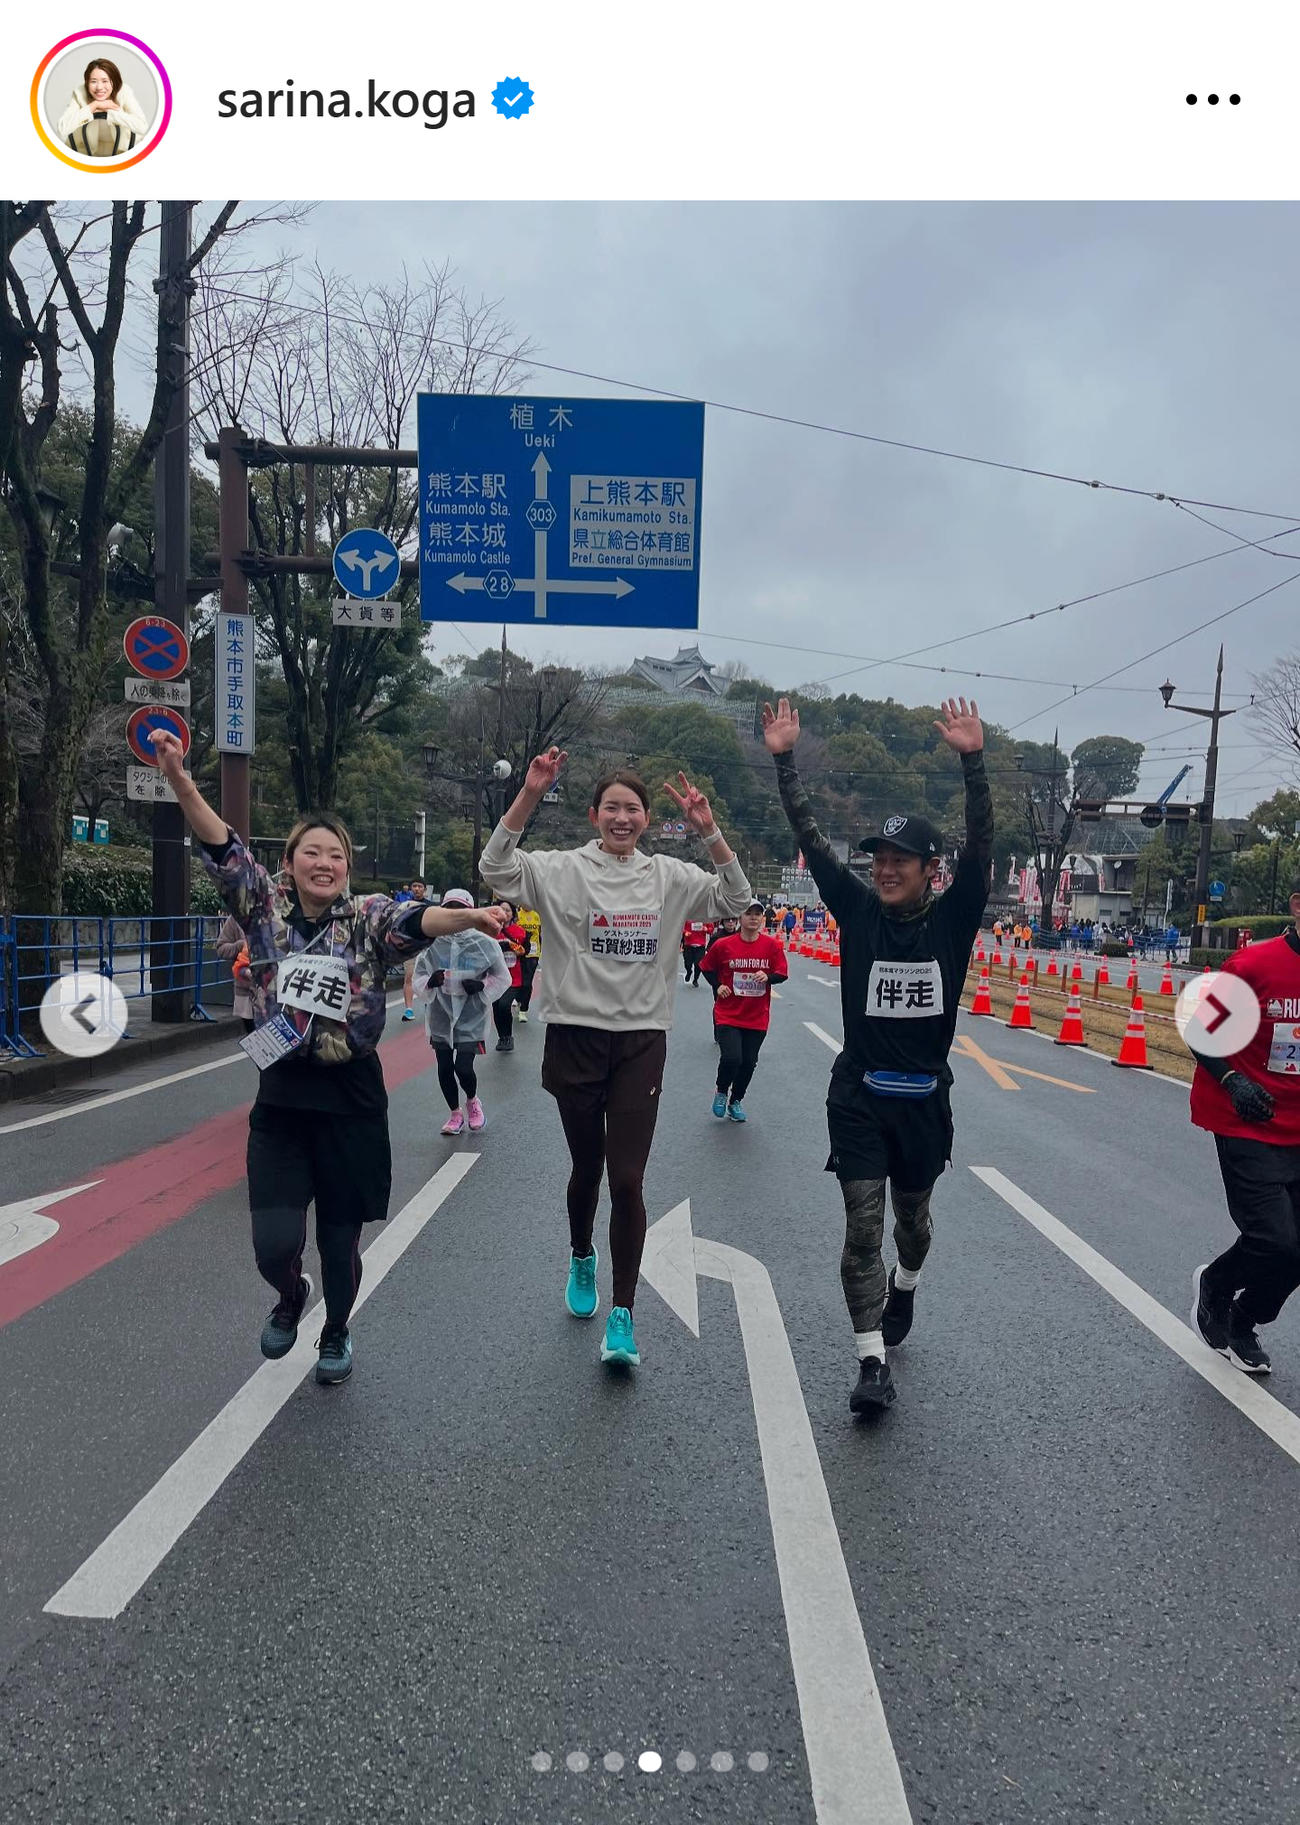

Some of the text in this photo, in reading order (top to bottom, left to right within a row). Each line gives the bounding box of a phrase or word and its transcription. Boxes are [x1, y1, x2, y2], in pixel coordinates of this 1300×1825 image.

[509, 403, 574, 432] 植木
[524, 434, 556, 448] Ueki
[427, 472, 508, 499] 熊本駅
[580, 480, 686, 507] 上熊本駅
[425, 500, 511, 517] Kumamoto Sta.
[530, 508, 552, 522] 303
[573, 508, 693, 525] Kamikumamoto Sta.
[428, 521, 507, 548] 熊本城
[573, 528, 691, 553] 県立総合体育館
[424, 550, 511, 565] Kumamoto Castle
[572, 553, 692, 567] Pref. General Gymnasium
[489, 576, 509, 592] 28
[337, 604, 395, 622] 大貨等
[226, 619, 244, 747] 熊本市手取本町
[603, 930, 648, 938] ゲストランナー
[591, 937, 658, 956] 古賀紗理那
[281, 967, 347, 1011] 伴走
[876, 978, 935, 1010] 伴走
